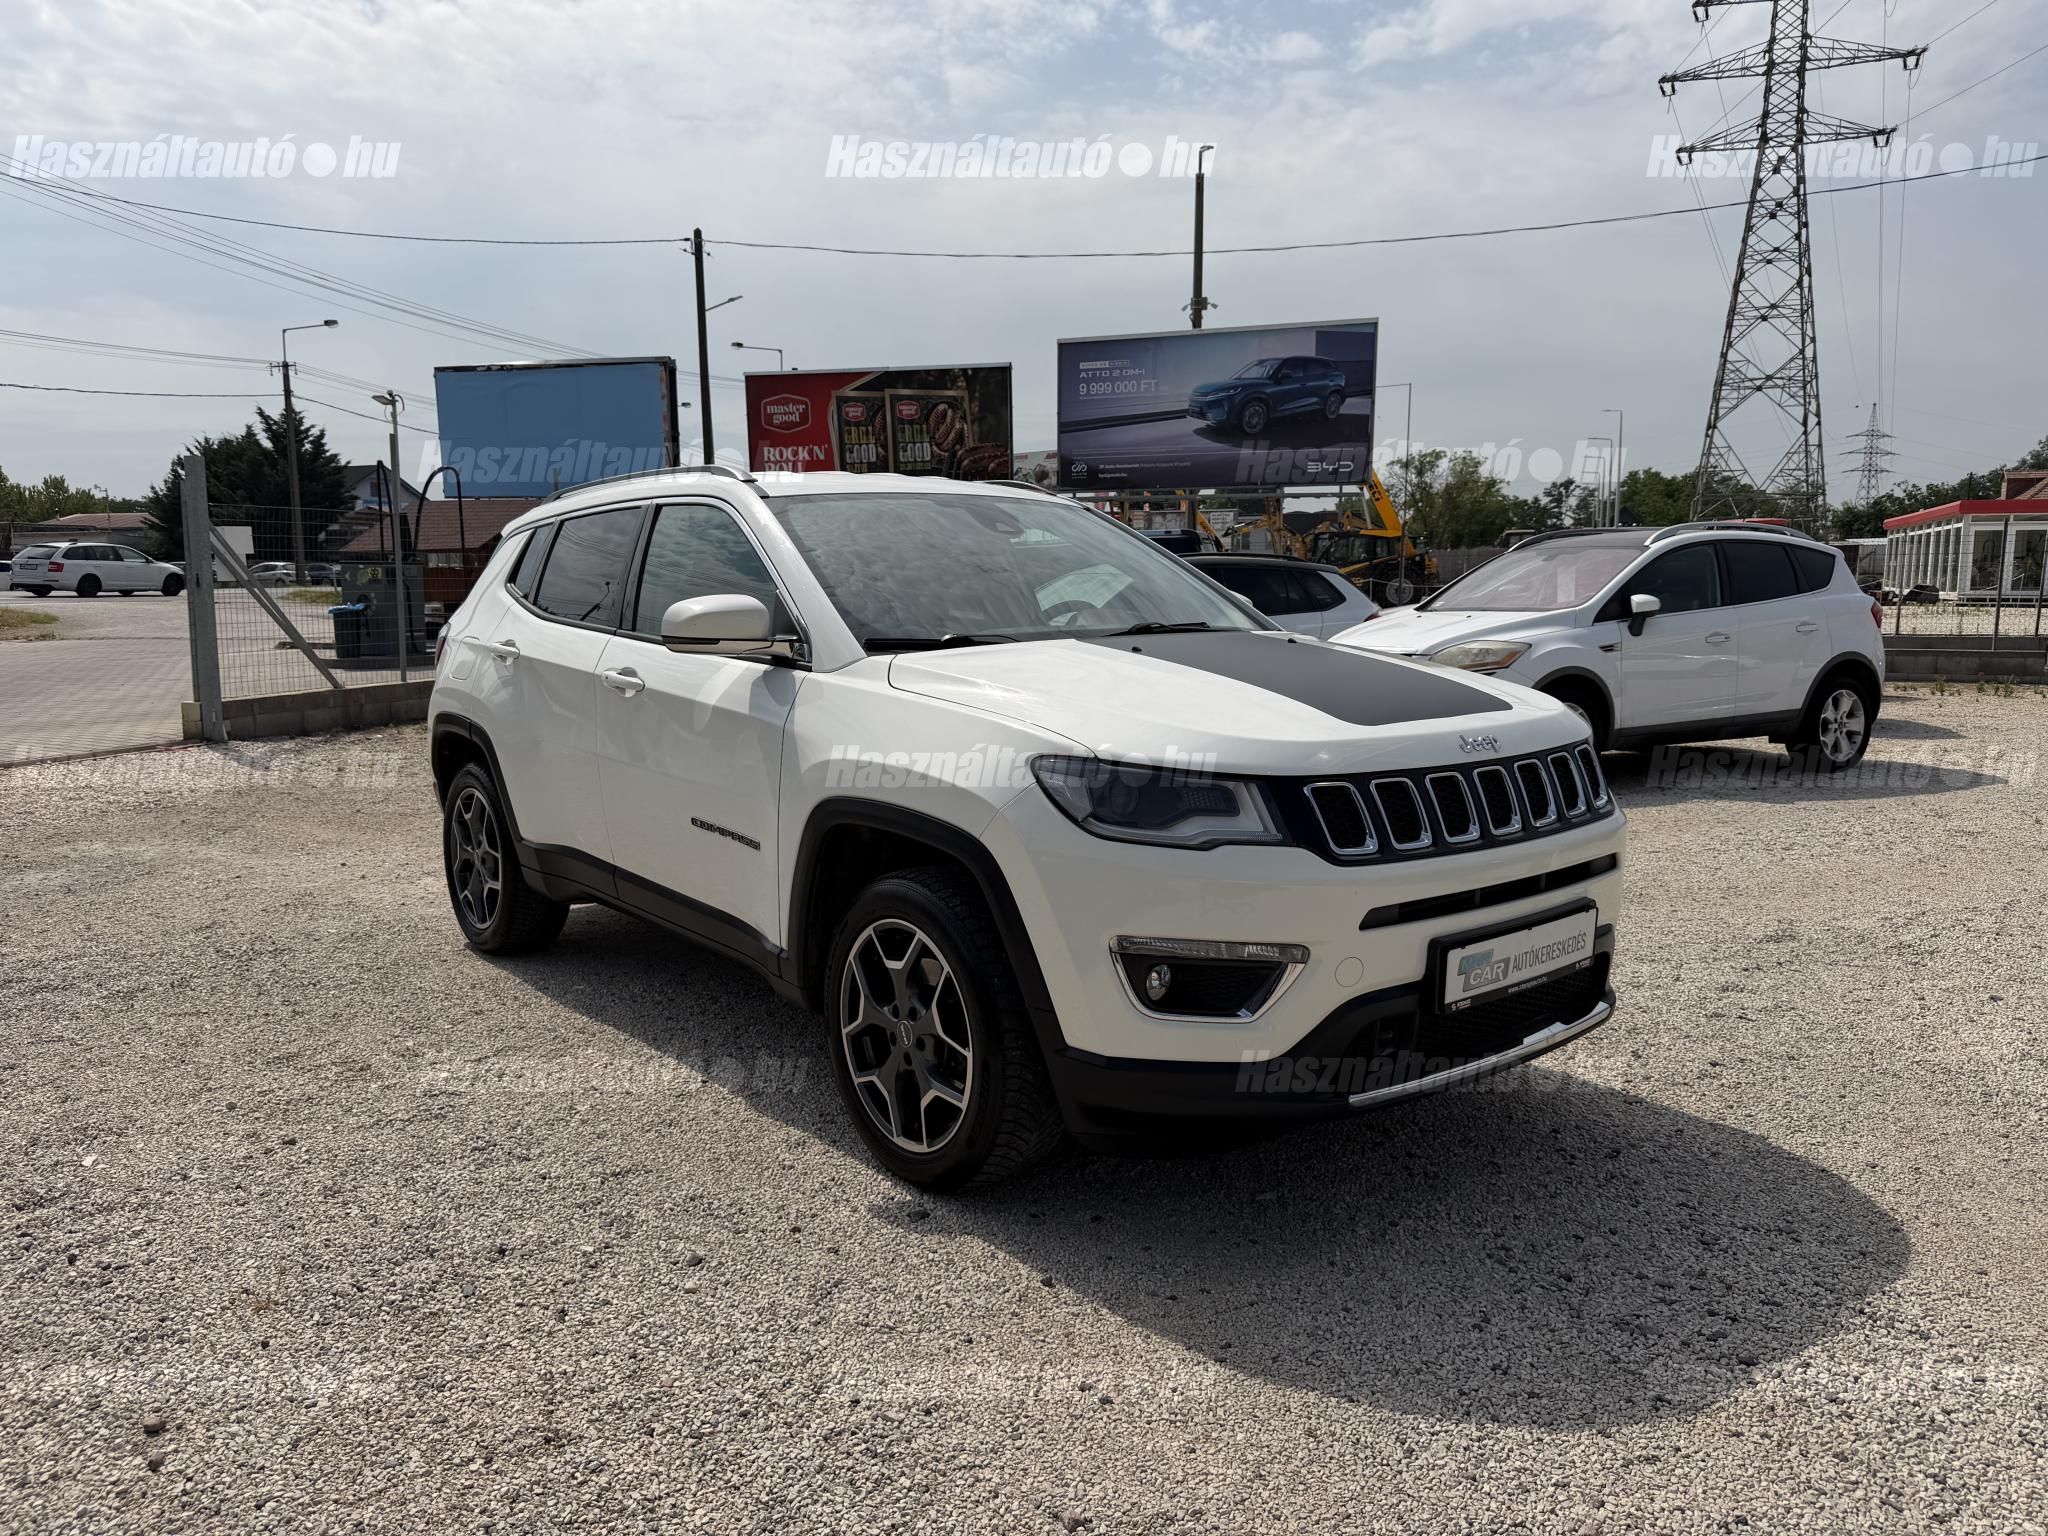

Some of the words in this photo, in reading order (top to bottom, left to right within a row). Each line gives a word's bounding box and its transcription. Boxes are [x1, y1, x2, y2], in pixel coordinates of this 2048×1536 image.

[1080, 370, 1110, 378] ATTO
[1112, 369, 1120, 377] 2
[1140, 379, 1158, 392] FT
[766, 402, 806, 414] master
[773, 411, 800, 425] good
[1307, 461, 1354, 472] BYD
[1459, 734, 1501, 753] Jeep
[690, 816, 761, 852] COMPASS
[1469, 962, 1505, 985] CAR
[1511, 929, 1587, 974] AUTÓKERESKEDÉS
